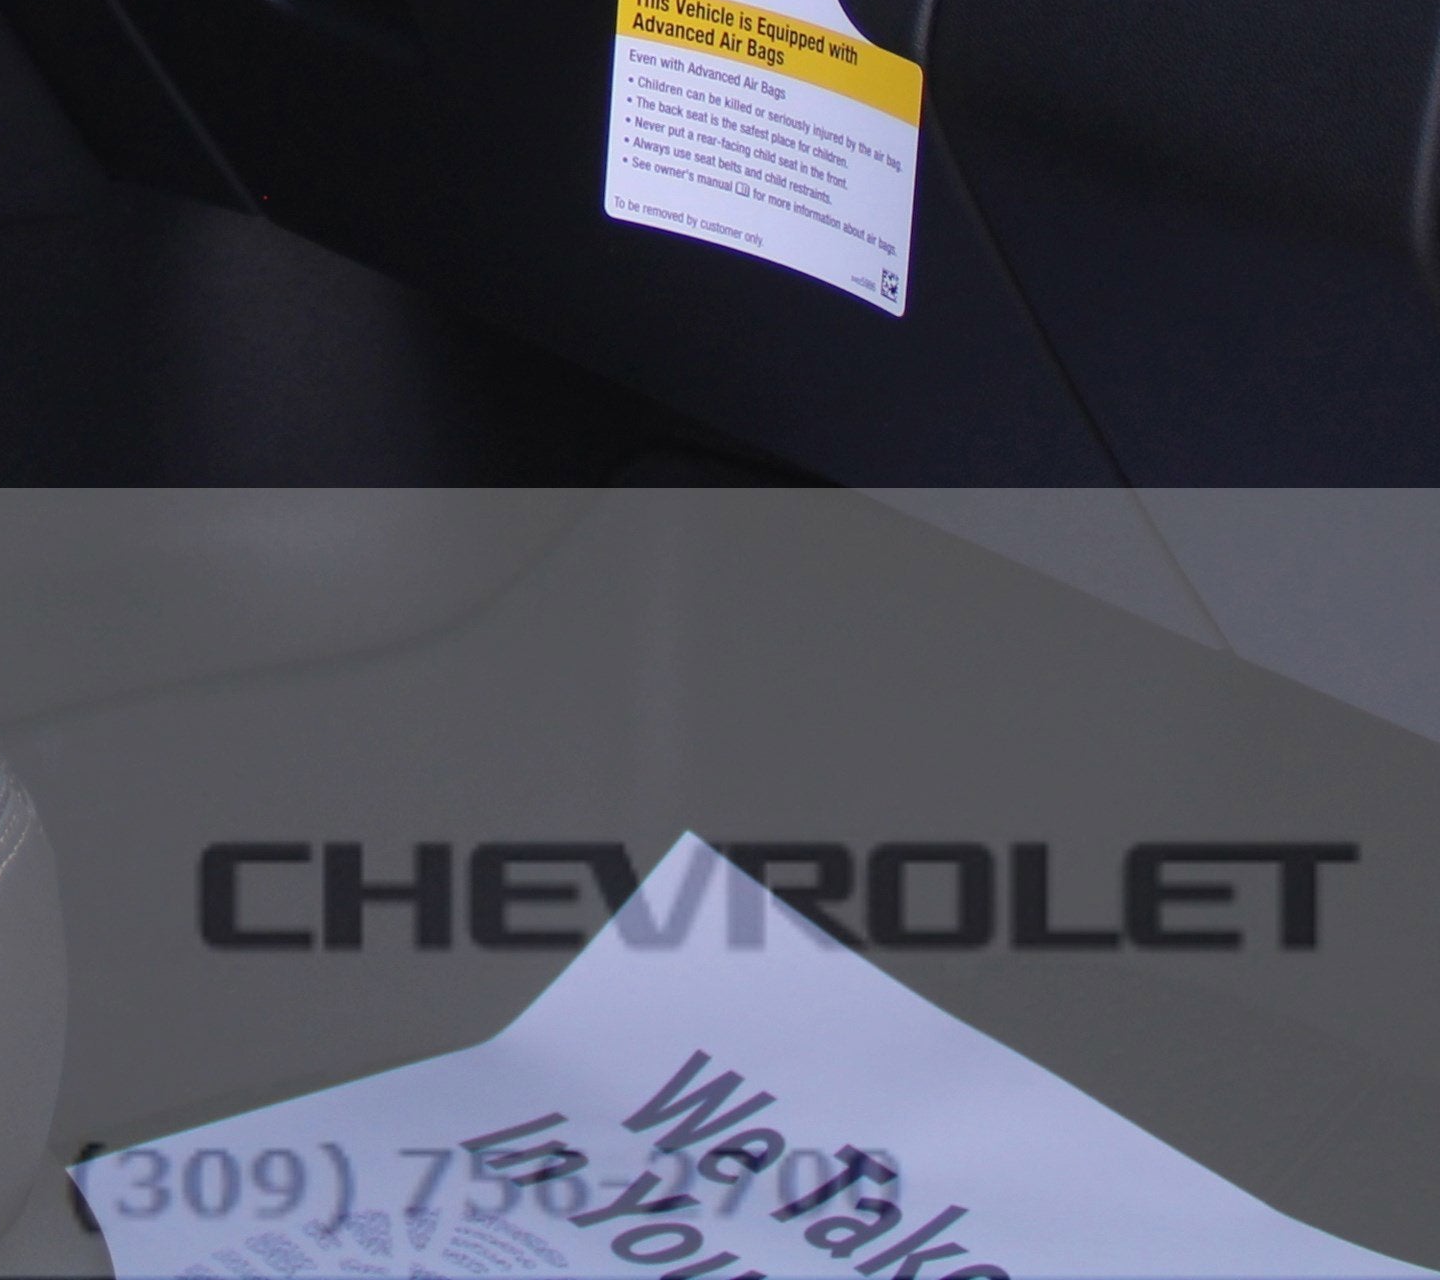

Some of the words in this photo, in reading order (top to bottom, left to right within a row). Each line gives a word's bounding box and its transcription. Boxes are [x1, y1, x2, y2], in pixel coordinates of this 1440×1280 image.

[632, 12, 715, 46] Advanced
[720, 31, 744, 53] Air
[747, 39, 785, 67] Bags
[739, 11, 753, 31] is
[757, 16, 825, 53] Equipped
[829, 41, 859, 65] with
[629, 48, 657, 66] Even
[660, 57, 685, 72] with
[687, 62, 741, 86] Advanced
[743, 76, 760, 91] Air
[760, 81, 786, 100] Bags
[634, 116, 666, 133] Never
[668, 124, 685, 139] put
[687, 130, 695, 141] a
[696, 133, 751, 159] rear-facing
[753, 148, 776, 164] child
[778, 155, 798, 171] seat
[800, 160, 808, 175] in
[810, 165, 824, 181] the
[636, 95, 656, 111] The
[658, 100, 683, 118] back
[686, 109, 708, 123] seat
[710, 112, 719, 127] is
[722, 117, 738, 131] the
[740, 125, 769, 141] safest
[771, 132, 796, 149] place
[798, 140, 811, 154] for
[812, 146, 848, 169] children.
[638, 76, 683, 97] Children
[686, 88, 706, 103] can
[708, 92, 722, 106] be
[724, 96, 752, 115] killed
[755, 106, 766, 118] or
[768, 110, 811, 135] seriously
[813, 123, 844, 145] injured
[846, 136, 857, 153] by
[858, 141, 872, 157] the
[873, 149, 885, 162] air
[632, 136, 670, 156] Always
[673, 147, 692, 160] use
[694, 152, 716, 167] seat
[718, 157, 742, 174] belts
[744, 167, 762, 181] and
[764, 172, 787, 188] child
[789, 179, 832, 205] restraints.
[632, 156, 652, 171] See
[654, 163, 694, 182] owner's
[697, 174, 733, 192] manual
[753, 187, 766, 201] for
[768, 194, 791, 211] more
[793, 201, 841, 230] information
[842, 222, 865, 241] about
[866, 232, 877, 245] air
[614, 196, 625, 209] To
[627, 199, 640, 212] be
[642, 203, 684, 223] removed
[686, 213, 698, 228] by
[700, 219, 743, 239] customer
[459, 1111, 589, 1188] In
[621, 1048, 787, 1185] We
